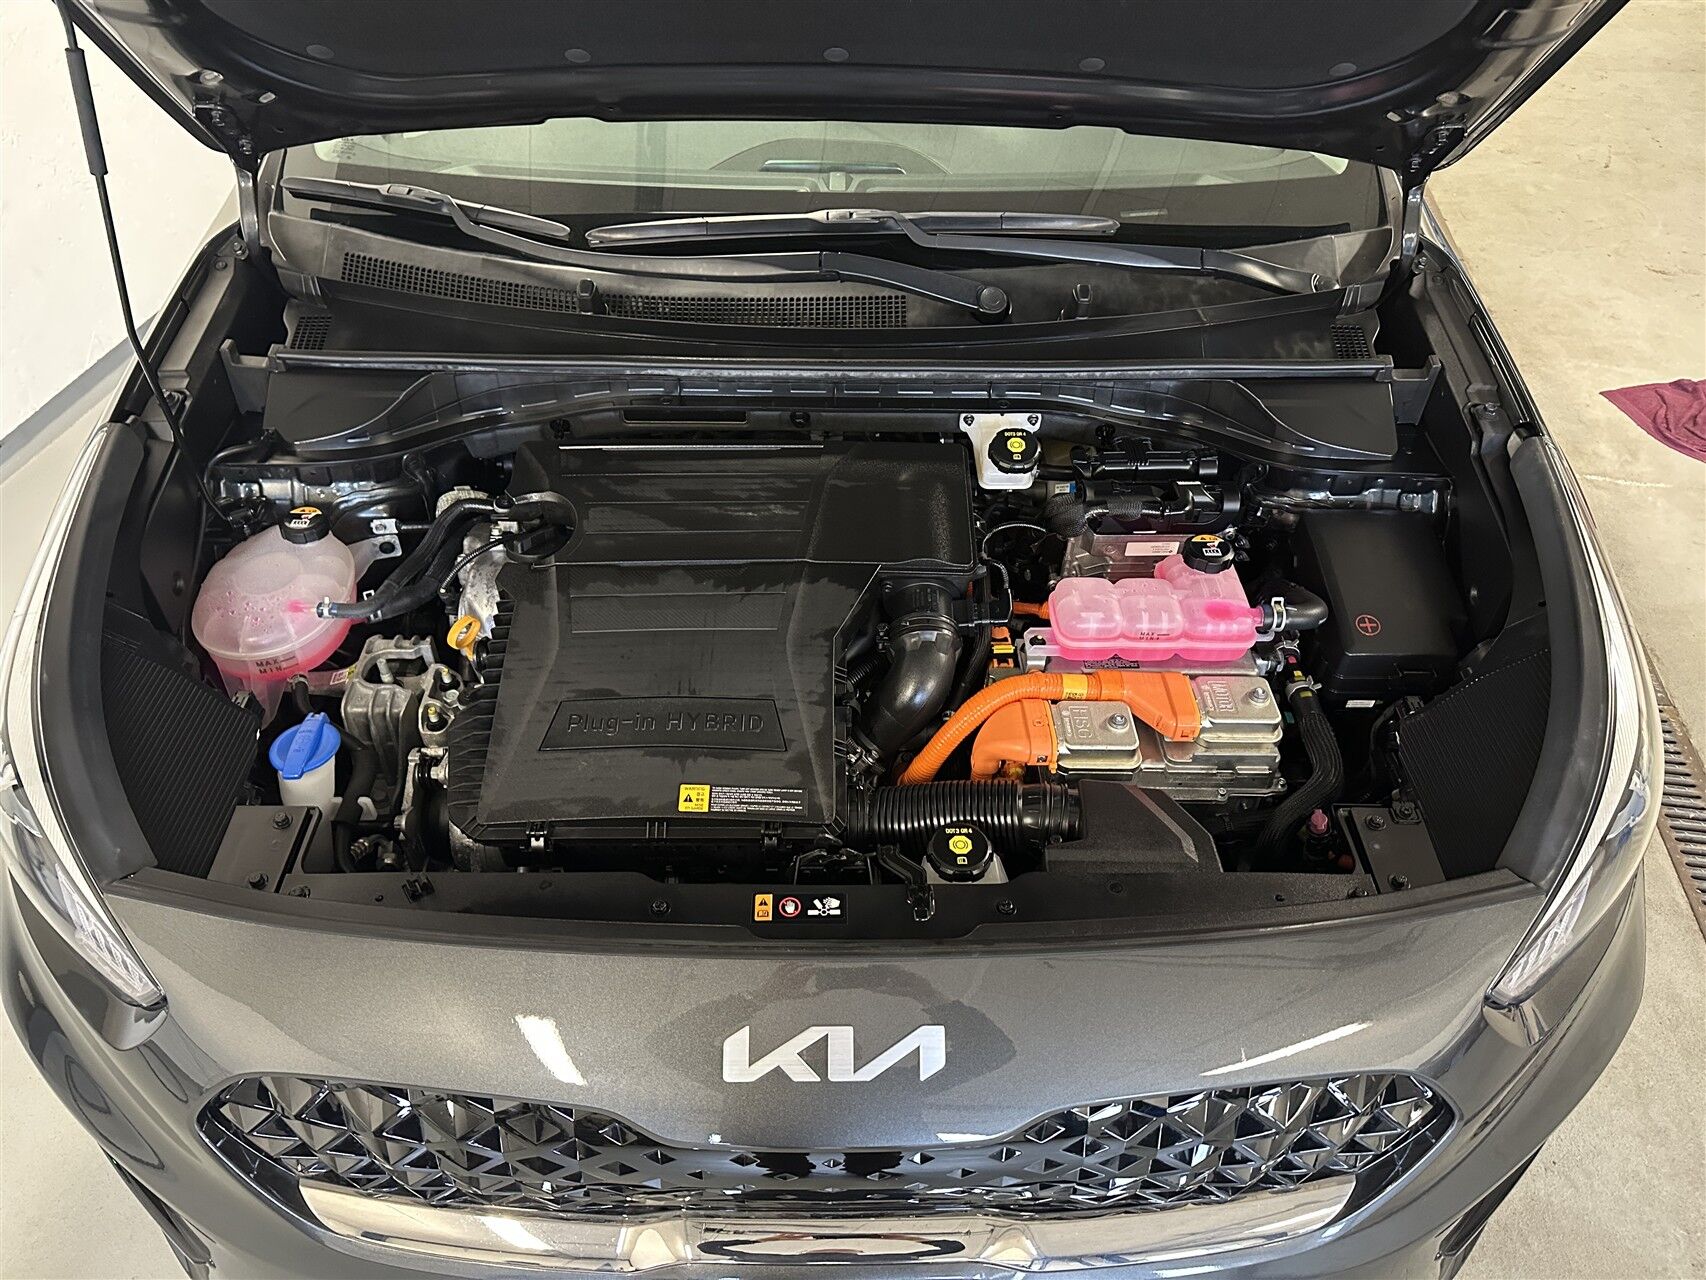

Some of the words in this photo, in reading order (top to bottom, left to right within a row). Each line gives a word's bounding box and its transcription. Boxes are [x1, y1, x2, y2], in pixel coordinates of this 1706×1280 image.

[255, 659, 280, 667] MAX
[259, 665, 282, 674] MIN
[568, 712, 656, 736] Plug-in
[666, 712, 764, 733] HYBRID
[723, 1025, 946, 1083] KIA
